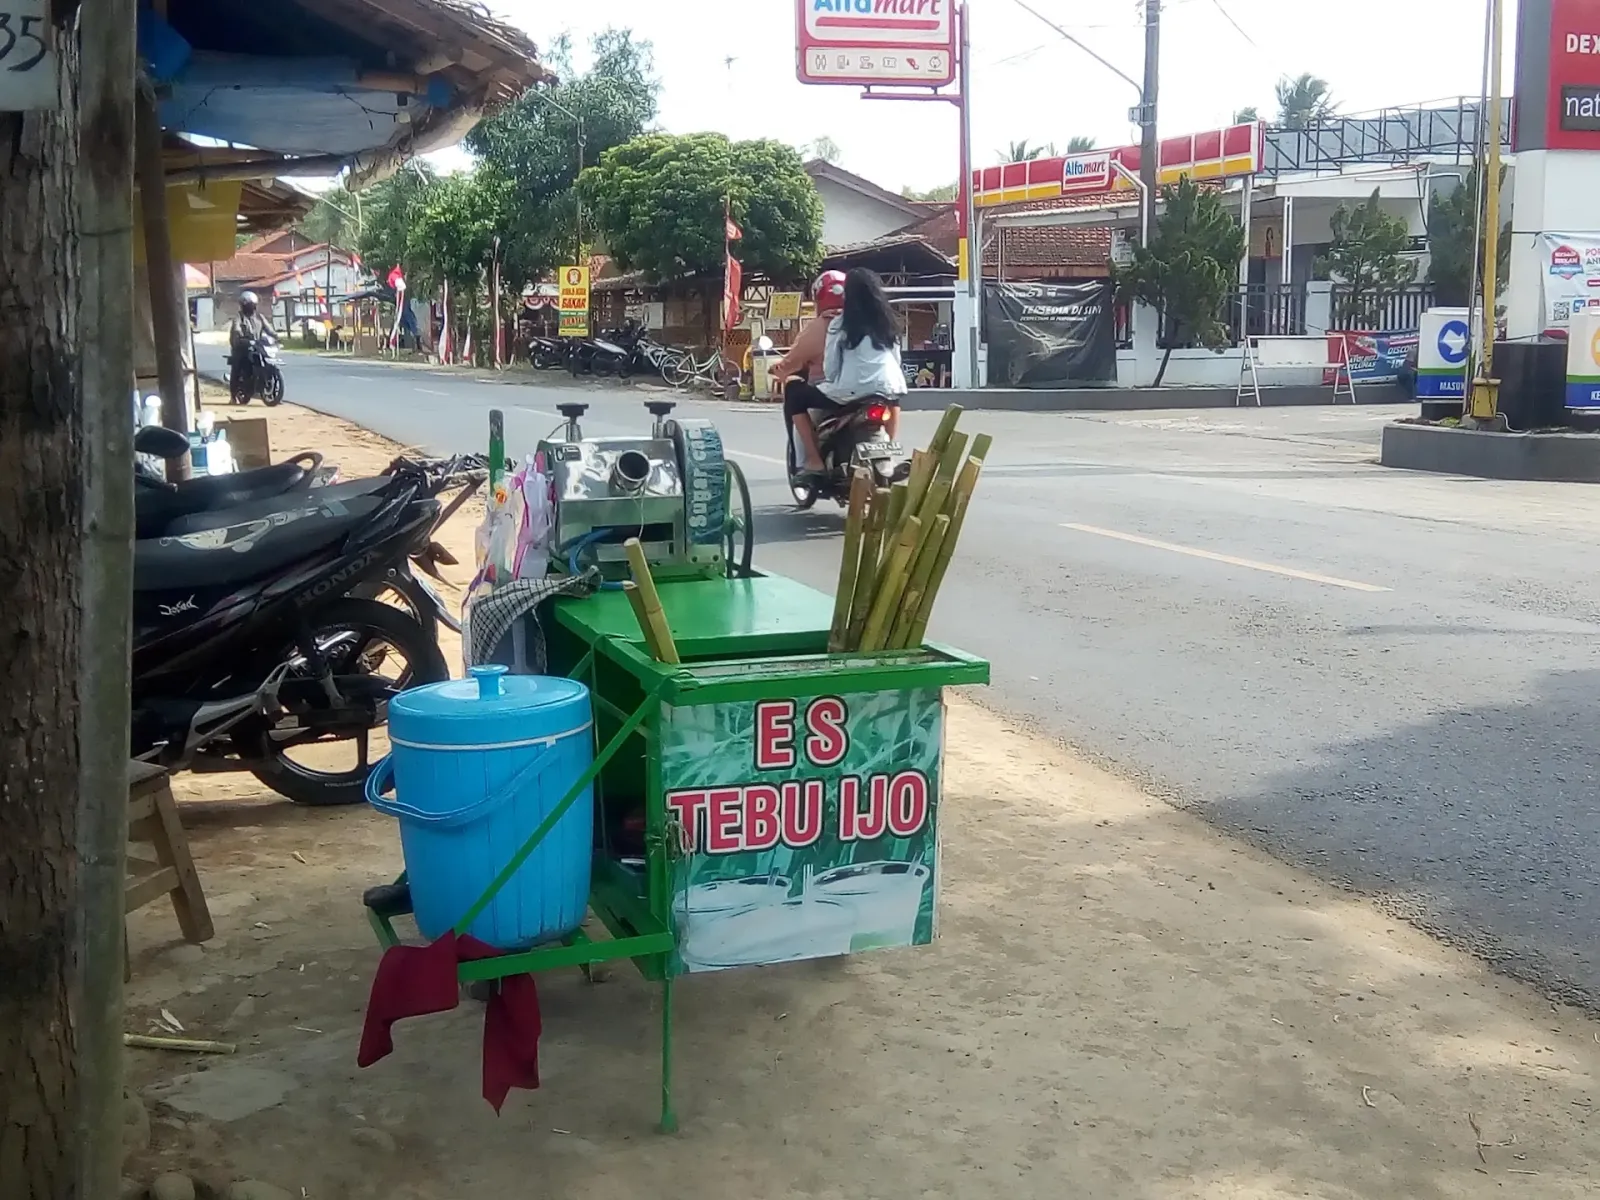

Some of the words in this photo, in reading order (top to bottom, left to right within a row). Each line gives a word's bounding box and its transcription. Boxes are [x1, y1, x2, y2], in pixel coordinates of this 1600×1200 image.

[1065, 160, 1105, 176] Alfamart
[294, 550, 384, 608] HONDA
[666, 780, 824, 856] TEBU
[838, 768, 930, 844] IJO
